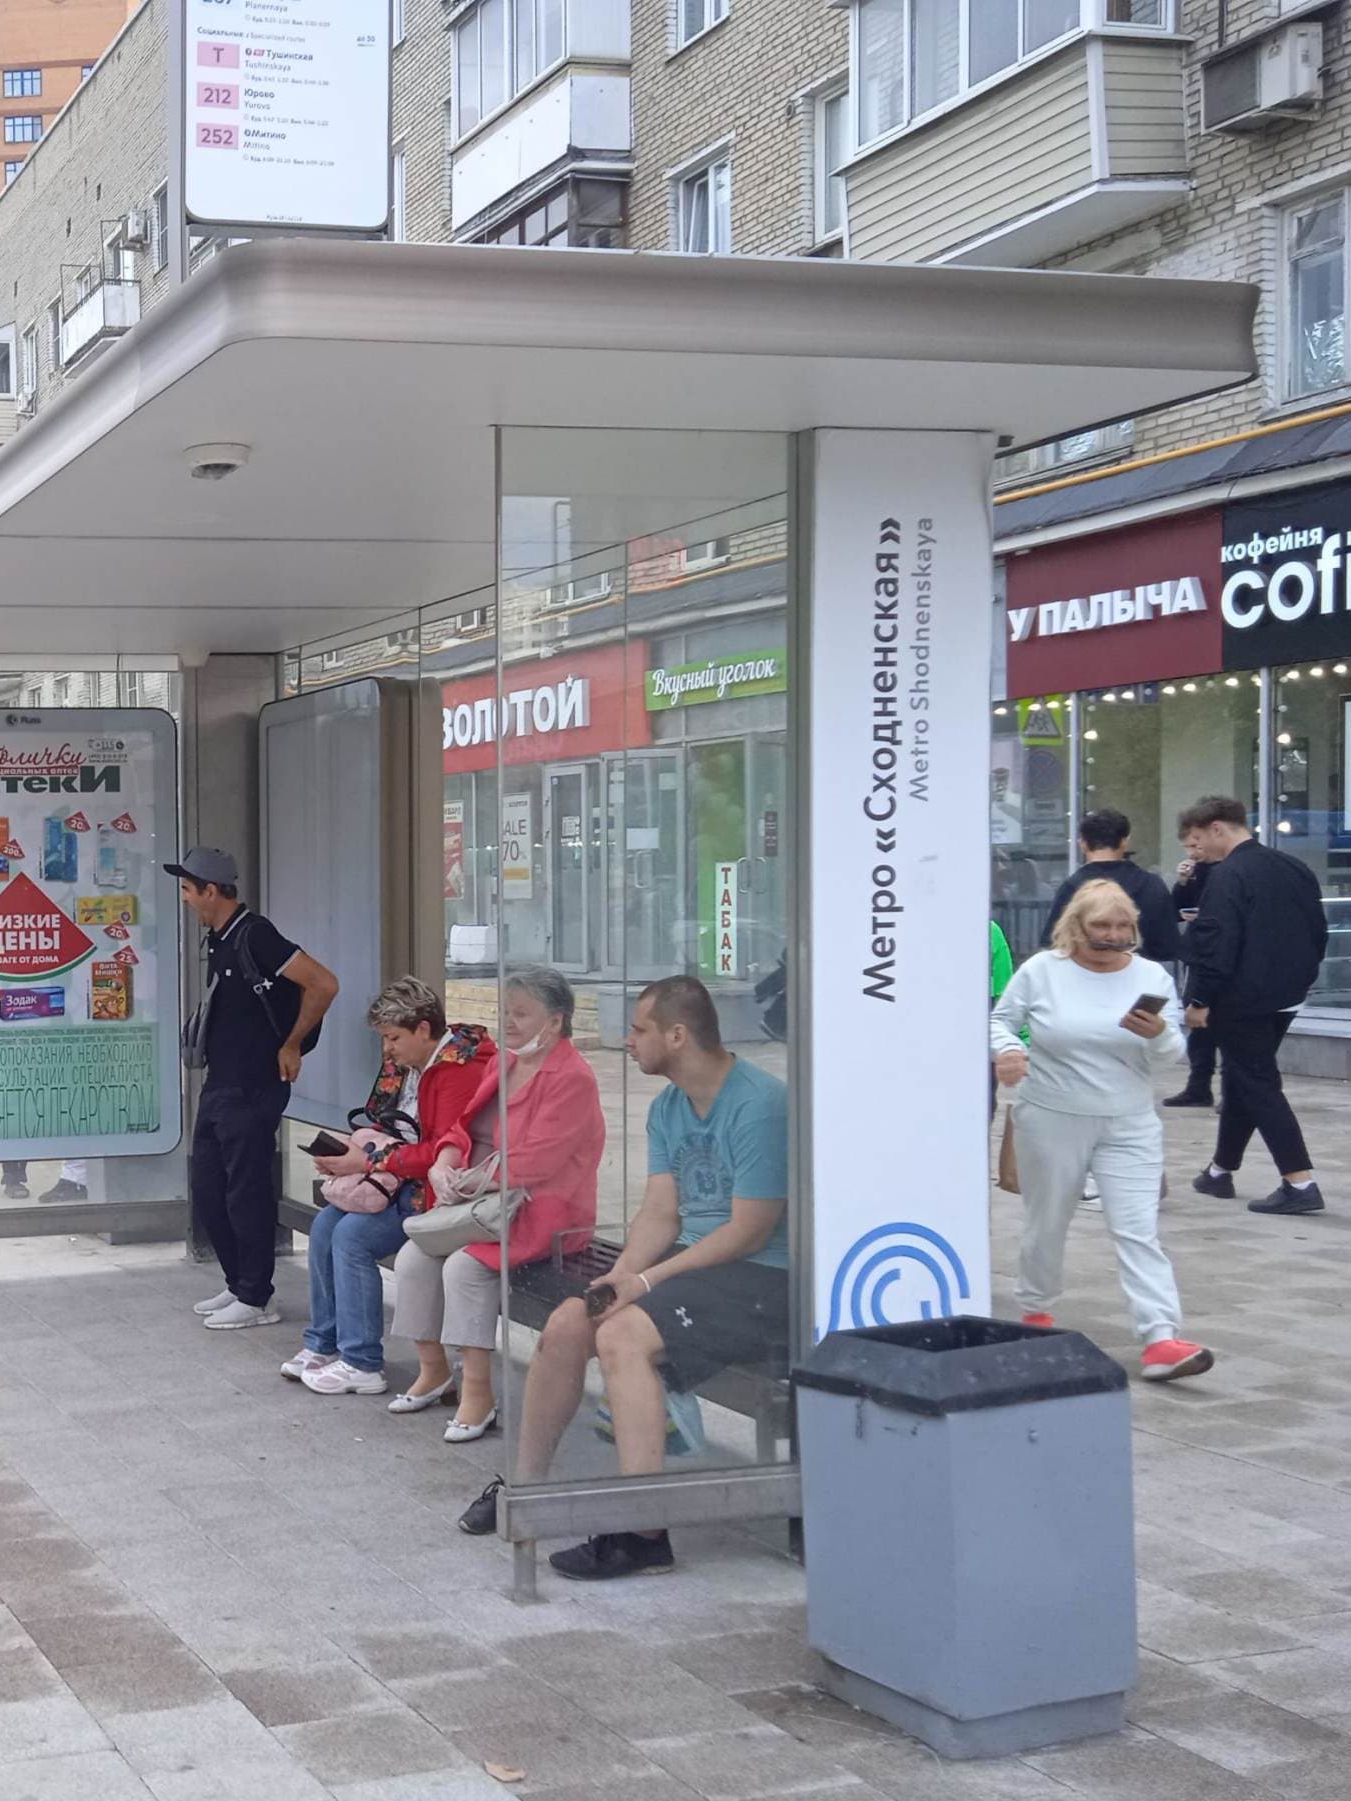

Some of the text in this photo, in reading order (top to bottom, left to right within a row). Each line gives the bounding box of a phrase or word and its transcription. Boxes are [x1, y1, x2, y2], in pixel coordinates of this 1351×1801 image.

[266, 49, 314, 61] Тушинская
[203, 87, 232, 104] 212
[244, 88, 275, 99] Юрово
[201, 128, 234, 145] 252
[251, 129, 287, 140] Митино
[1220, 526, 1323, 564] кофейня
[1007, 576, 1206, 642] У ПАЛЫЧА
[909, 516, 938, 802] Metro Shodnenskaya
[651, 657, 777, 706] Вкусный уголок
[862, 516, 905, 1003] Метро «Сходненская»
[503, 819, 528, 836] ALE
[721, 867, 732, 971] ТАБАК
[32, 955, 59, 964] ДОМА
[5, 995, 38, 1007] Зодак
[78, 1043, 153, 1063] НЕОБХОДИМО
[72, 1063, 153, 1085] СПЕЦИАЛИСТА
